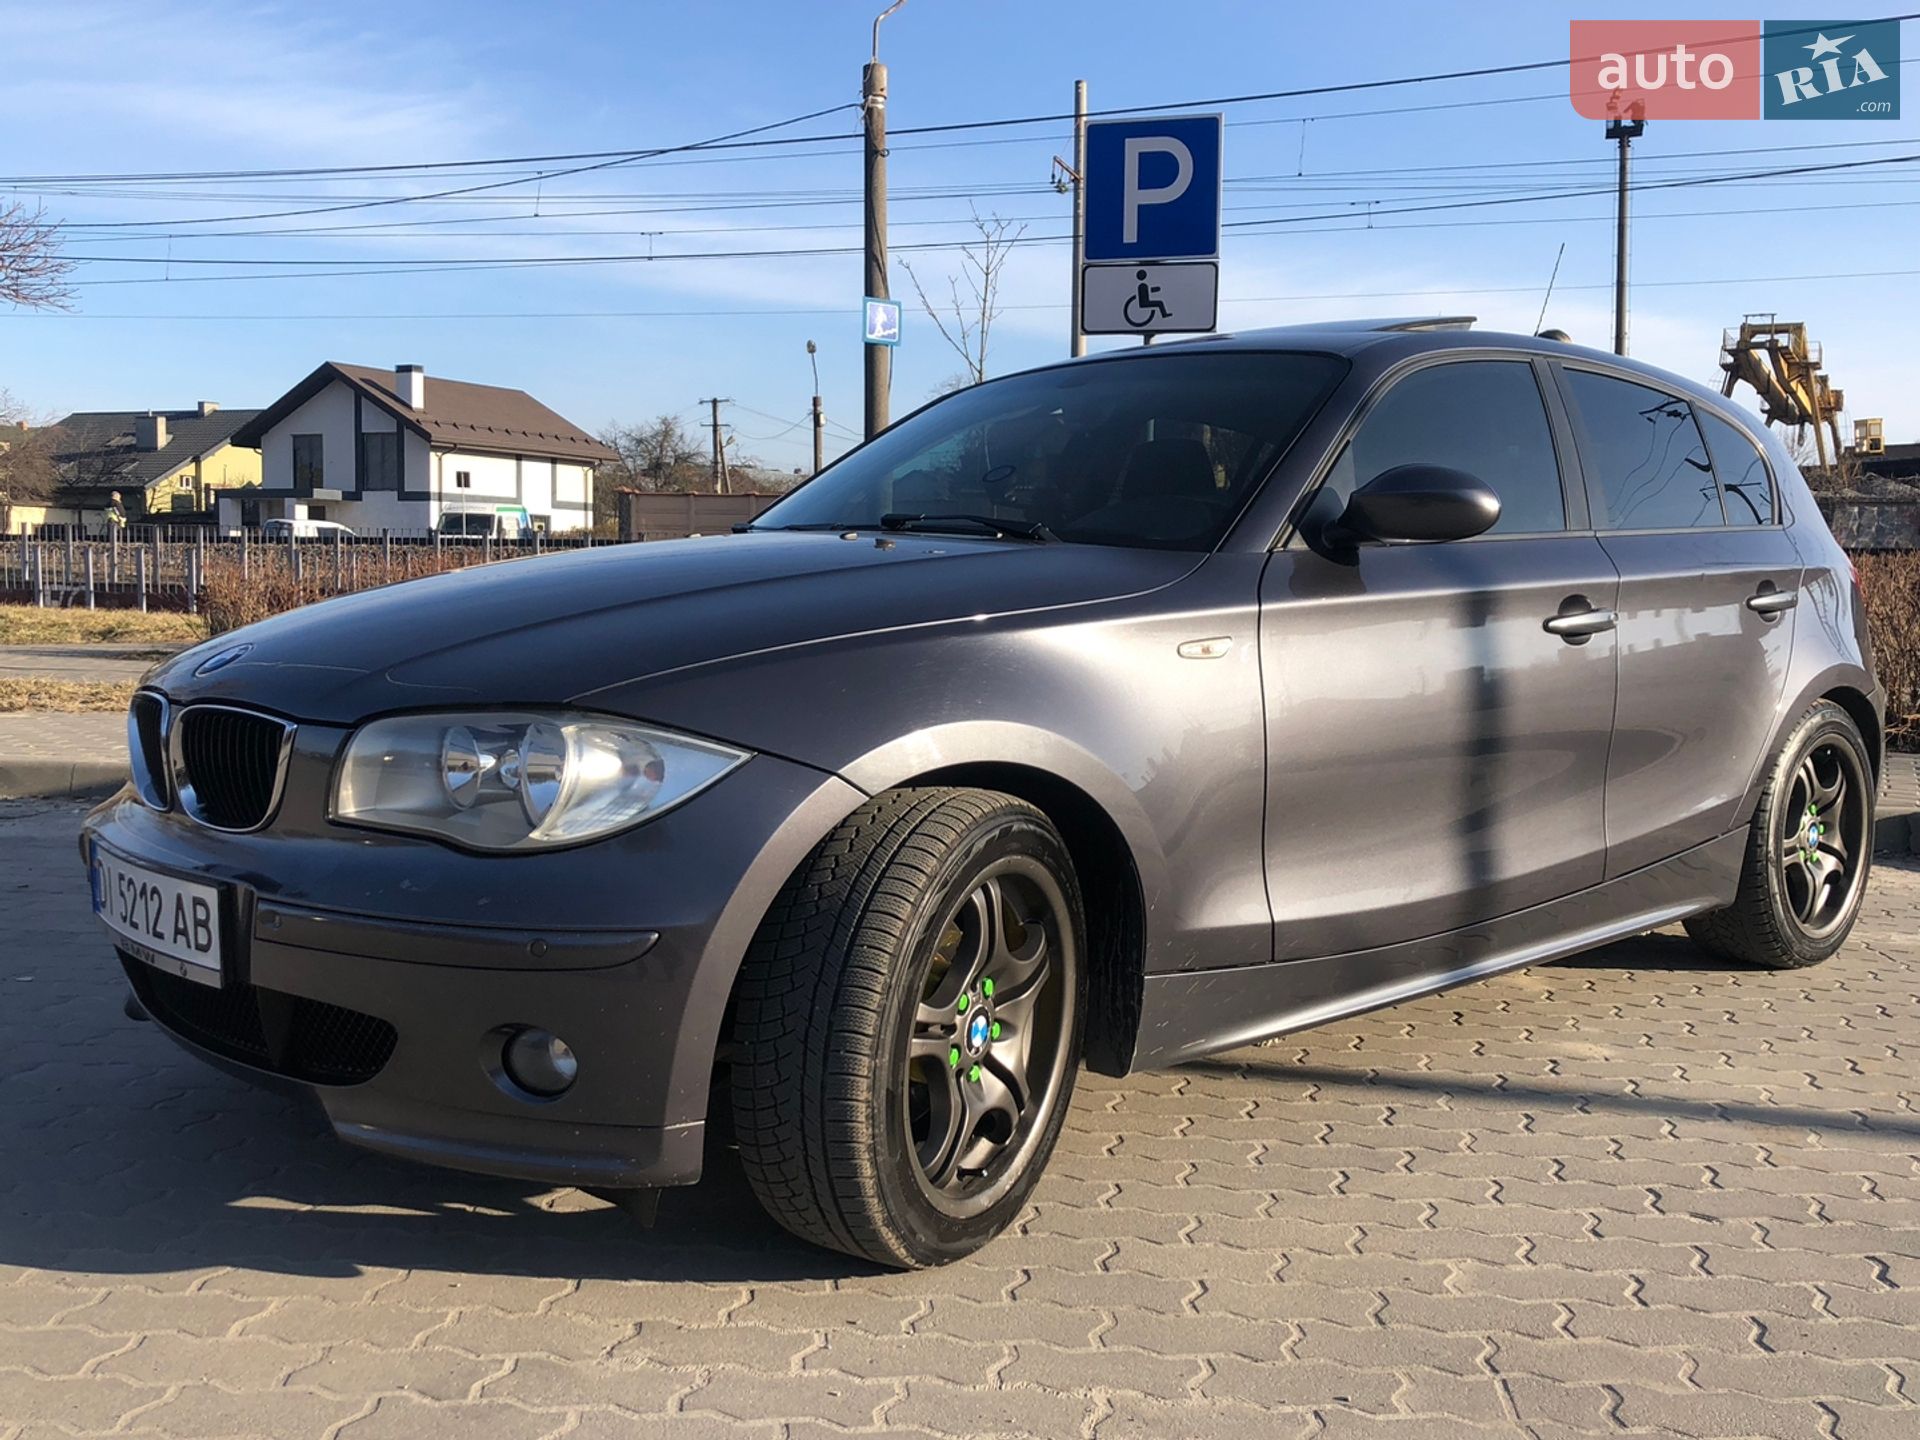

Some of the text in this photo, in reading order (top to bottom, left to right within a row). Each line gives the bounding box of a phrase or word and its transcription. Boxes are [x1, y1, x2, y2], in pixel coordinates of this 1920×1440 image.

[1123, 136, 1193, 243] P
[118, 871, 165, 940] 5212
[173, 892, 212, 953] AB
